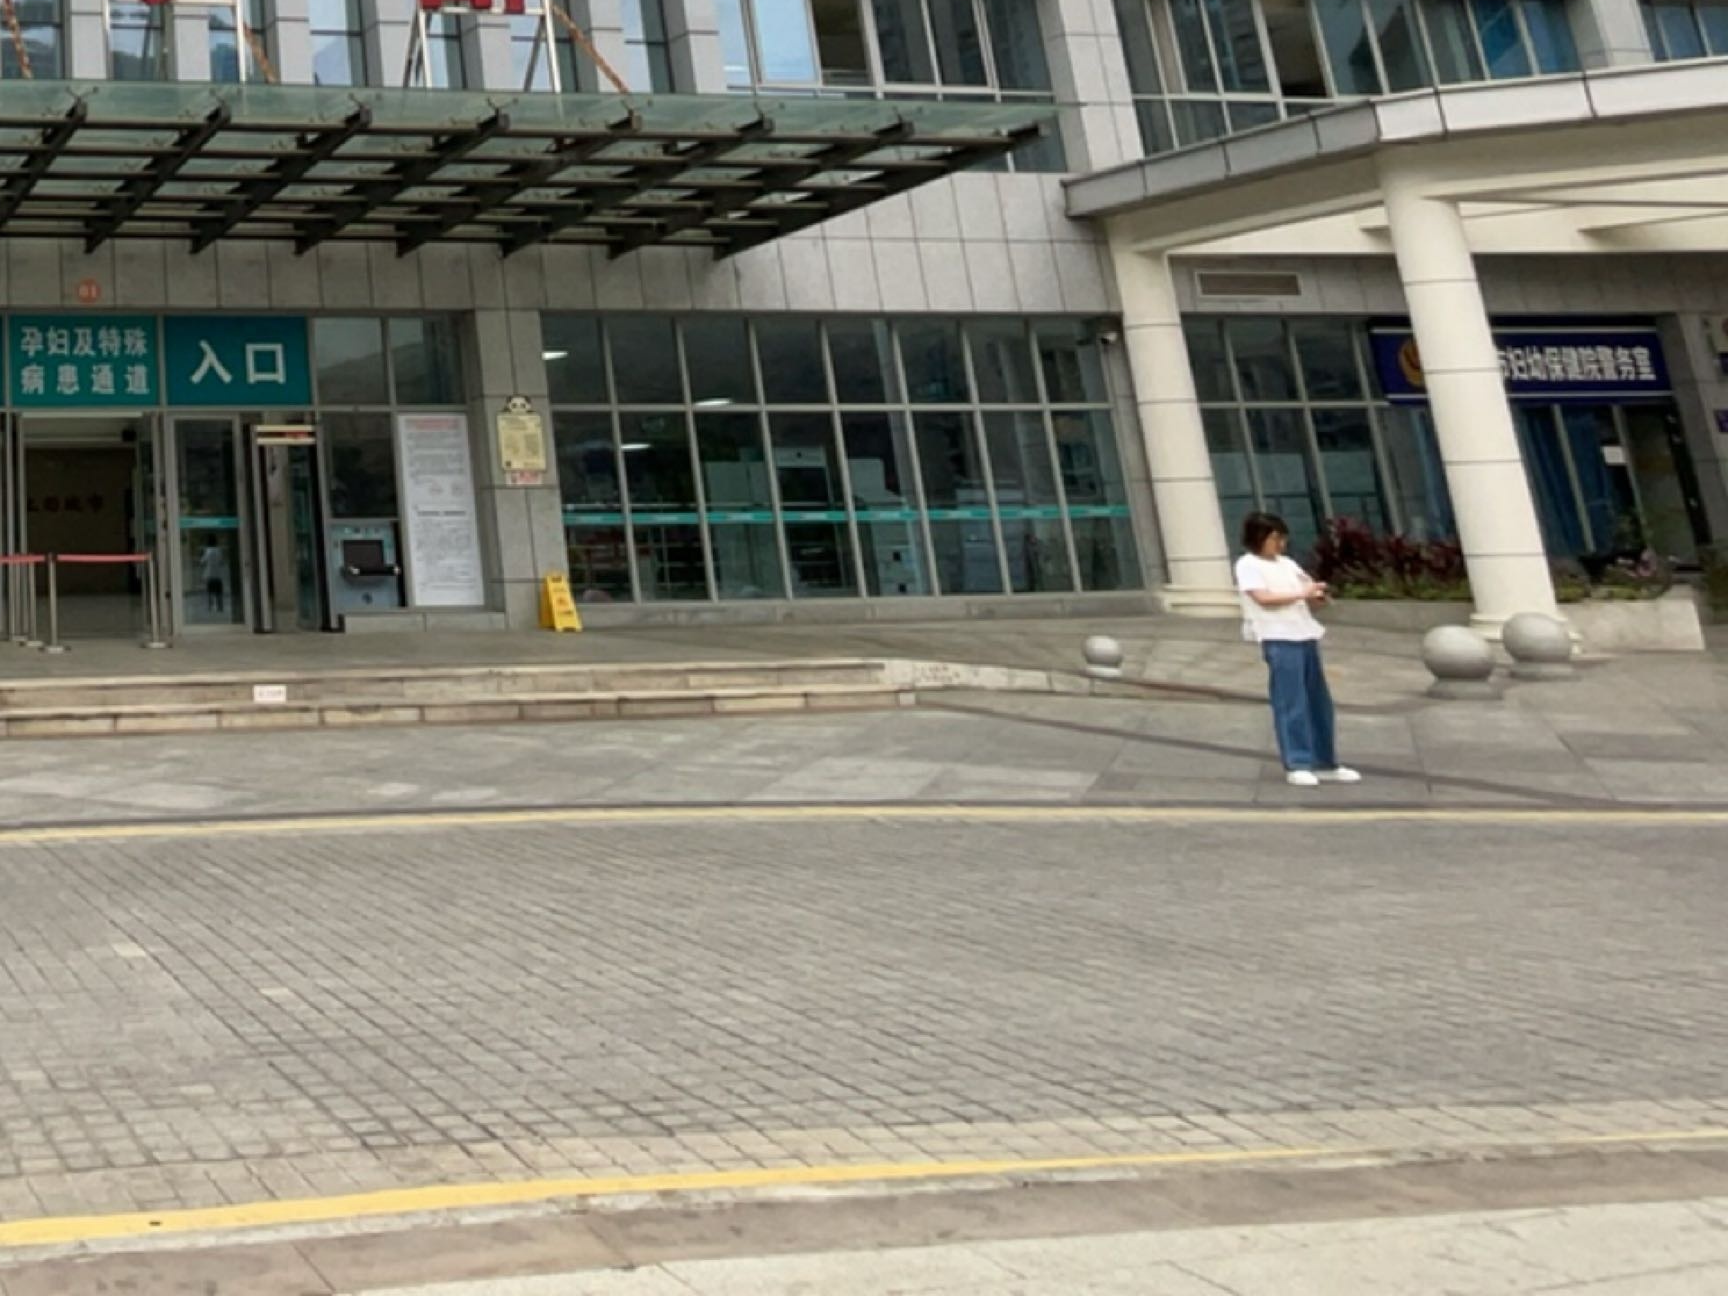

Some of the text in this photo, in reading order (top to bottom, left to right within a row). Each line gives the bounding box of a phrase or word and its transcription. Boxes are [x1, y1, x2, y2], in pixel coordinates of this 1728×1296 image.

[20, 326, 148, 358] 孕妇及特殊
[20, 362, 150, 396] 病患通道
[190, 340, 287, 385] 入口
